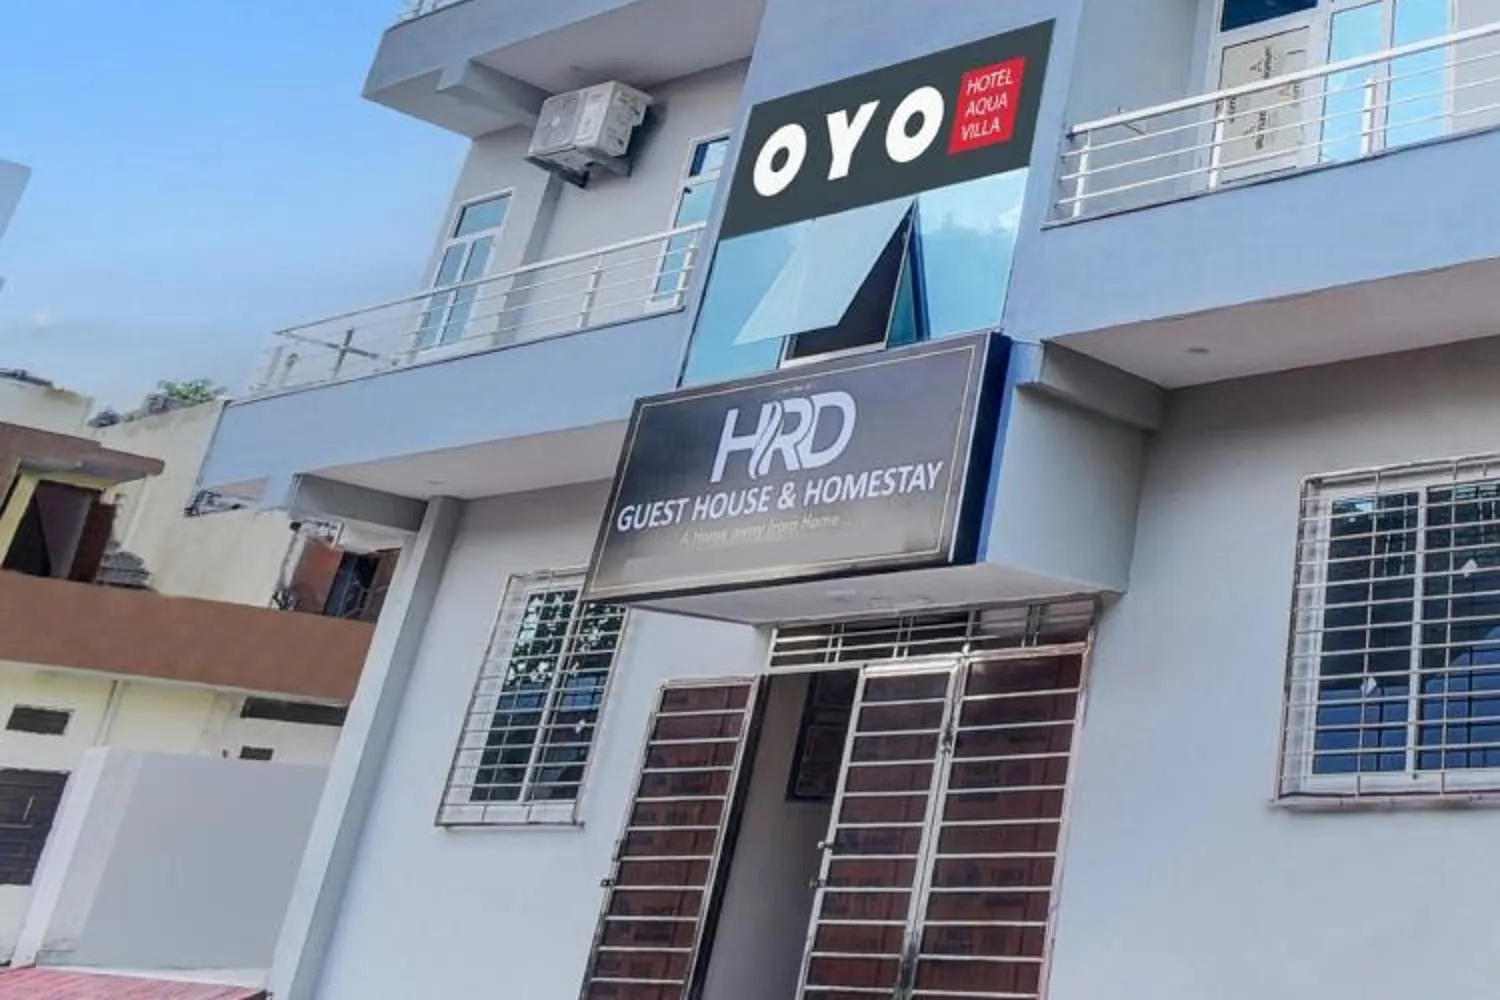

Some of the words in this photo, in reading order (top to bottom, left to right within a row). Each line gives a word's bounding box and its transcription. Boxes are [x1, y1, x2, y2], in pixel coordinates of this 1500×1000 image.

[964, 92, 1008, 119] AQUA
[966, 67, 1013, 96] HOTEL
[753, 86, 945, 197] OYO
[961, 117, 1000, 141] VILLA
[710, 391, 857, 484] HRD
[617, 497, 690, 532] GUEST
[691, 485, 774, 521] HOUSE
[777, 481, 797, 510] &
[803, 460, 944, 507] HOMESTAY
